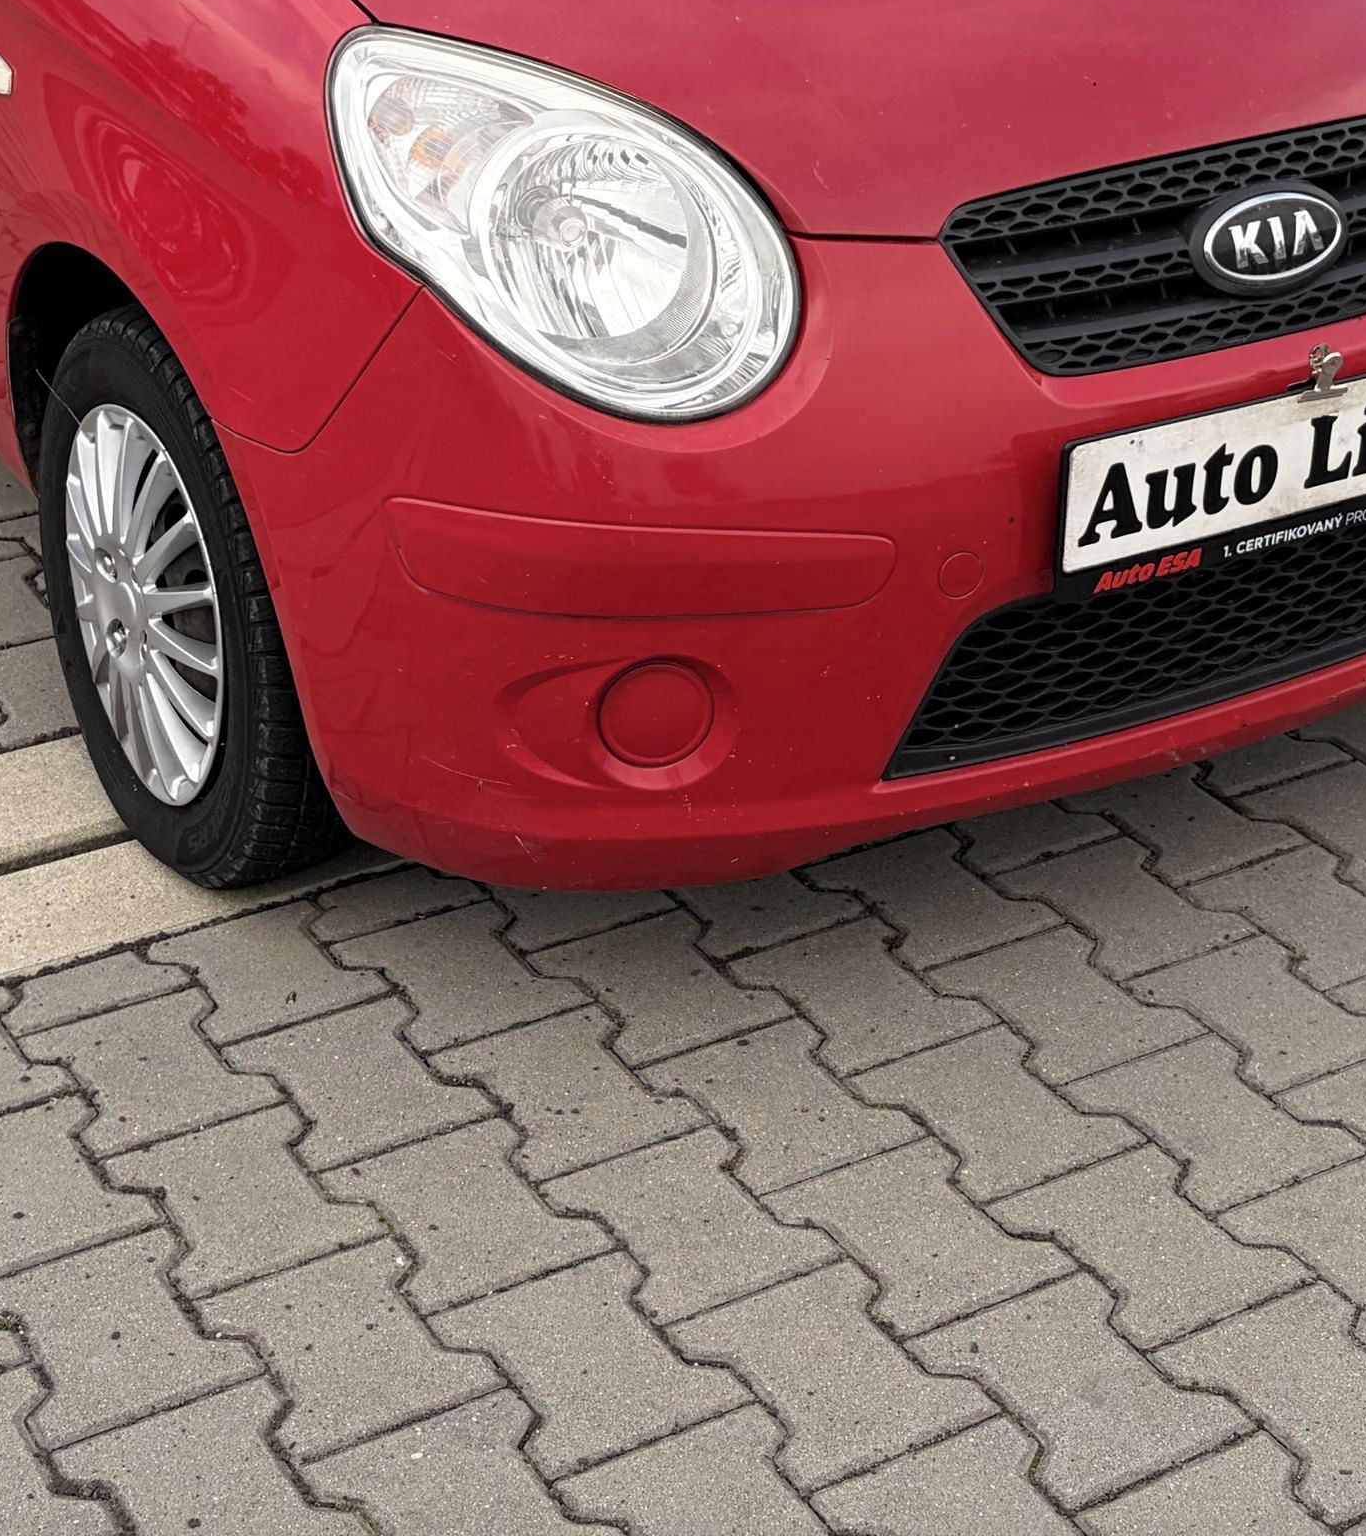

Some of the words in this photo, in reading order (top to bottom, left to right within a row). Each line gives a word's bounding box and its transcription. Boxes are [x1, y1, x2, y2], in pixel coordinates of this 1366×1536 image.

[1228, 209, 1324, 269] KIA
[1078, 443, 1278, 547] Auto
[1236, 515, 1344, 554] CERTIFIKOVANÝ
[1093, 562, 1155, 594] Auto
[1155, 547, 1203, 578] ESA
